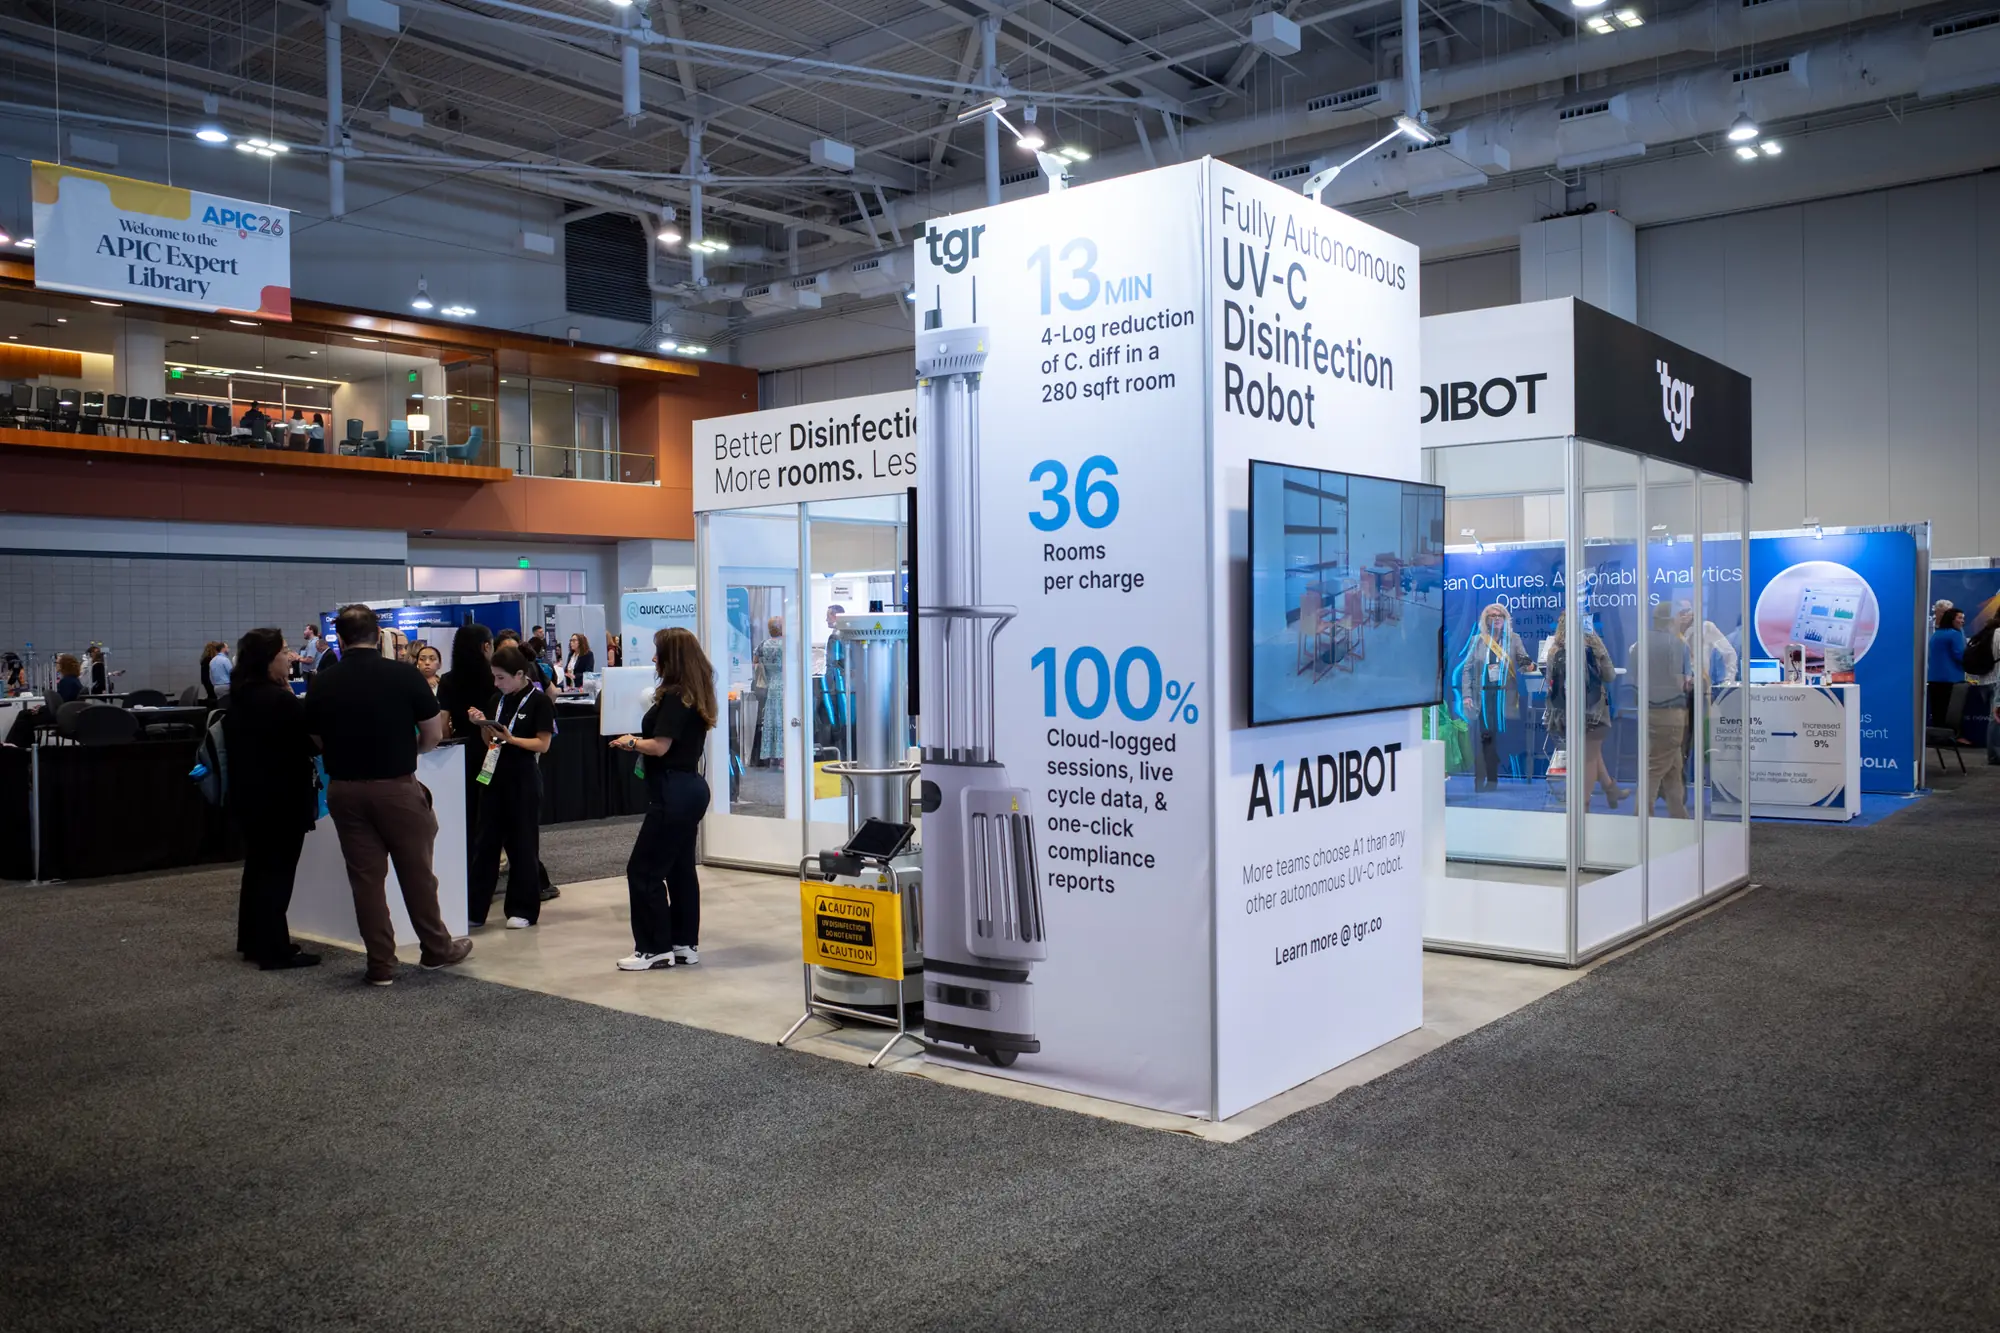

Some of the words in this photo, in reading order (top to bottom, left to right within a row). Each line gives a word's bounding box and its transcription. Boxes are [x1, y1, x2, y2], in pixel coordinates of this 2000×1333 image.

[119, 218, 180, 241] Welcome
[182, 229, 195, 243] to
[197, 232, 218, 247] the
[202, 206, 284, 236] APIC26
[926, 223, 986, 274] tgr
[1223, 186, 1276, 249] Fully
[1284, 214, 1405, 291] Autonomous
[96, 234, 161, 264] APIC
[167, 244, 239, 276] Expert
[128, 264, 211, 299] Library
[1027, 237, 1101, 315] 13
[1105, 273, 1152, 305] MIN
[1223, 236, 1307, 310] UV-C
[1041, 324, 1096, 346] 4-Log
[1102, 308, 1195, 338] reduction
[1042, 355, 1060, 375] of
[1064, 352, 1083, 371] C.
[1089, 345, 1121, 369] diff
[1127, 344, 1143, 363] in
[1149, 345, 1159, 360] a
[1224, 299, 1393, 391] Disinfection
[1042, 380, 1077, 403] 280
[1083, 376, 1120, 401] sqft
[1125, 373, 1176, 393] room
[1225, 361, 1315, 429] Robot
[1657, 359, 1694, 442] tgr
[715, 430, 782, 461] Better
[715, 466, 770, 494] More
[778, 458, 863, 487] rooms.
[1028, 455, 1119, 532] 36
[1044, 543, 1106, 562] Rooms
[1044, 574, 1074, 595] per
[1079, 570, 1145, 593] charge
[1471, 572, 1549, 590] Cultures.
[1496, 591, 1562, 614] Optimal
[1031, 646, 1199, 725] 100%
[1762, 694, 1777, 703] you
[1779, 693, 1806, 702] know?
[1802, 721, 1841, 730] Increased
[1806, 730, 1837, 738] CLABSI
[1047, 728, 1177, 755] Cloud-logged
[1813, 739, 1829, 748] 9%
[1047, 758, 1134, 784] sessions,
[1140, 761, 1174, 782] live
[1247, 759, 1284, 821] A1
[1293, 742, 1402, 813] ADIBOT
[1048, 787, 1095, 808] cycle
[1101, 789, 1148, 814] data,
[1154, 791, 1168, 811] &
[1048, 816, 1134, 838] one-click
[1048, 844, 1155, 869] compliance
[1243, 862, 1273, 885] More
[1276, 852, 1310, 878] teams
[1313, 843, 1350, 867] choose
[1353, 838, 1364, 856] A1
[1367, 833, 1387, 853] than
[1390, 829, 1405, 848] any
[1049, 872, 1115, 894] reports
[1246, 892, 1276, 915] other
[1280, 873, 1345, 906] autonomous
[1349, 864, 1375, 887] UV-C
[1377, 856, 1403, 880] robot.
[828, 902, 870, 918] CAUTION
[830, 945, 873, 961] CAUTION
[1275, 941, 1308, 966] Learn
[1310, 931, 1338, 955] more
[1341, 924, 1351, 947] @
[1353, 915, 1382, 944] tgr.co
